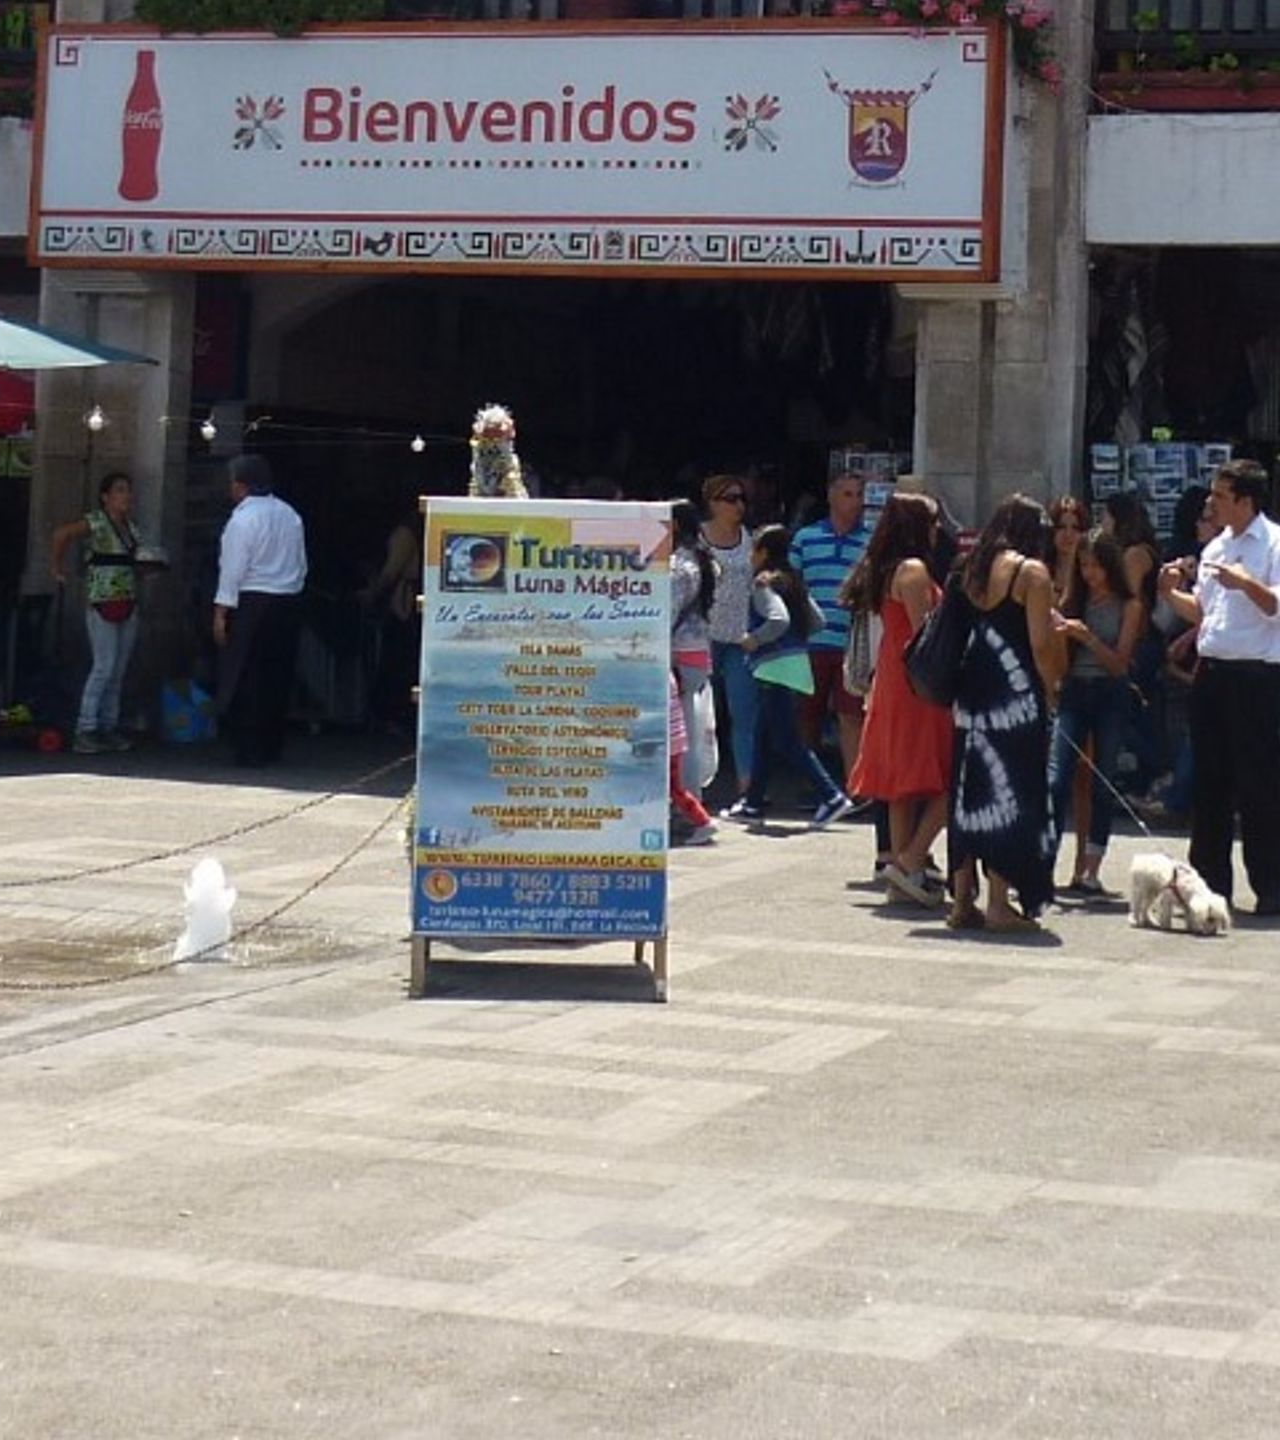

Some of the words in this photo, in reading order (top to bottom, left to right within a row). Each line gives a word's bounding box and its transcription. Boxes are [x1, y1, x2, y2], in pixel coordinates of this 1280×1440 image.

[302, 85, 697, 145] Bienvenidos
[514, 536, 650, 572] Turismo
[515, 574, 566, 594] Luna
[574, 573, 652, 600] Mágica
